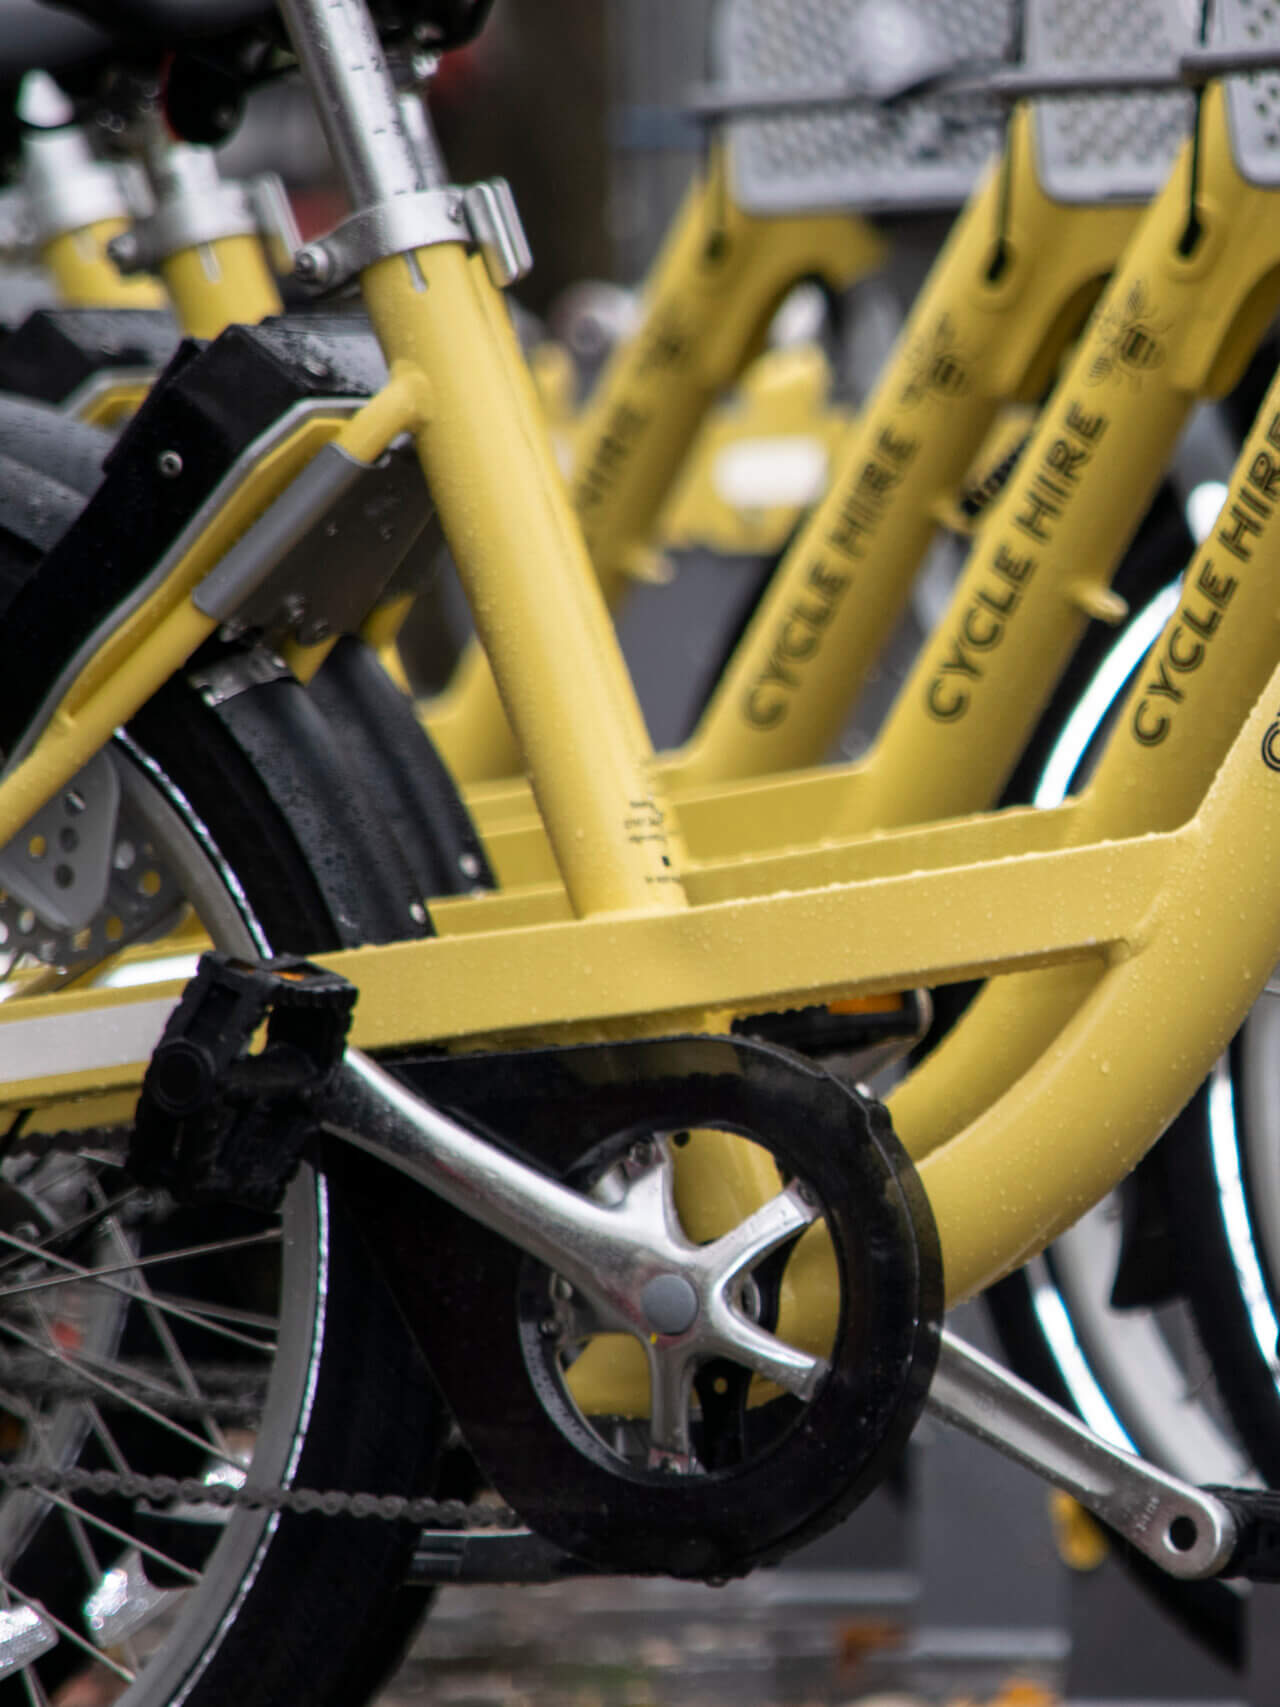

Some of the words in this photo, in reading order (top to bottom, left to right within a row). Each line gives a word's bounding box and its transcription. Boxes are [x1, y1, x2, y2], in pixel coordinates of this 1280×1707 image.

[742, 561, 850, 730] CYCLE
[829, 426, 918, 558] HIRE
[926, 545, 1037, 724] CYCLE
[1013, 401, 1108, 545] HIRE
[1131, 558, 1240, 748] CYCLE
